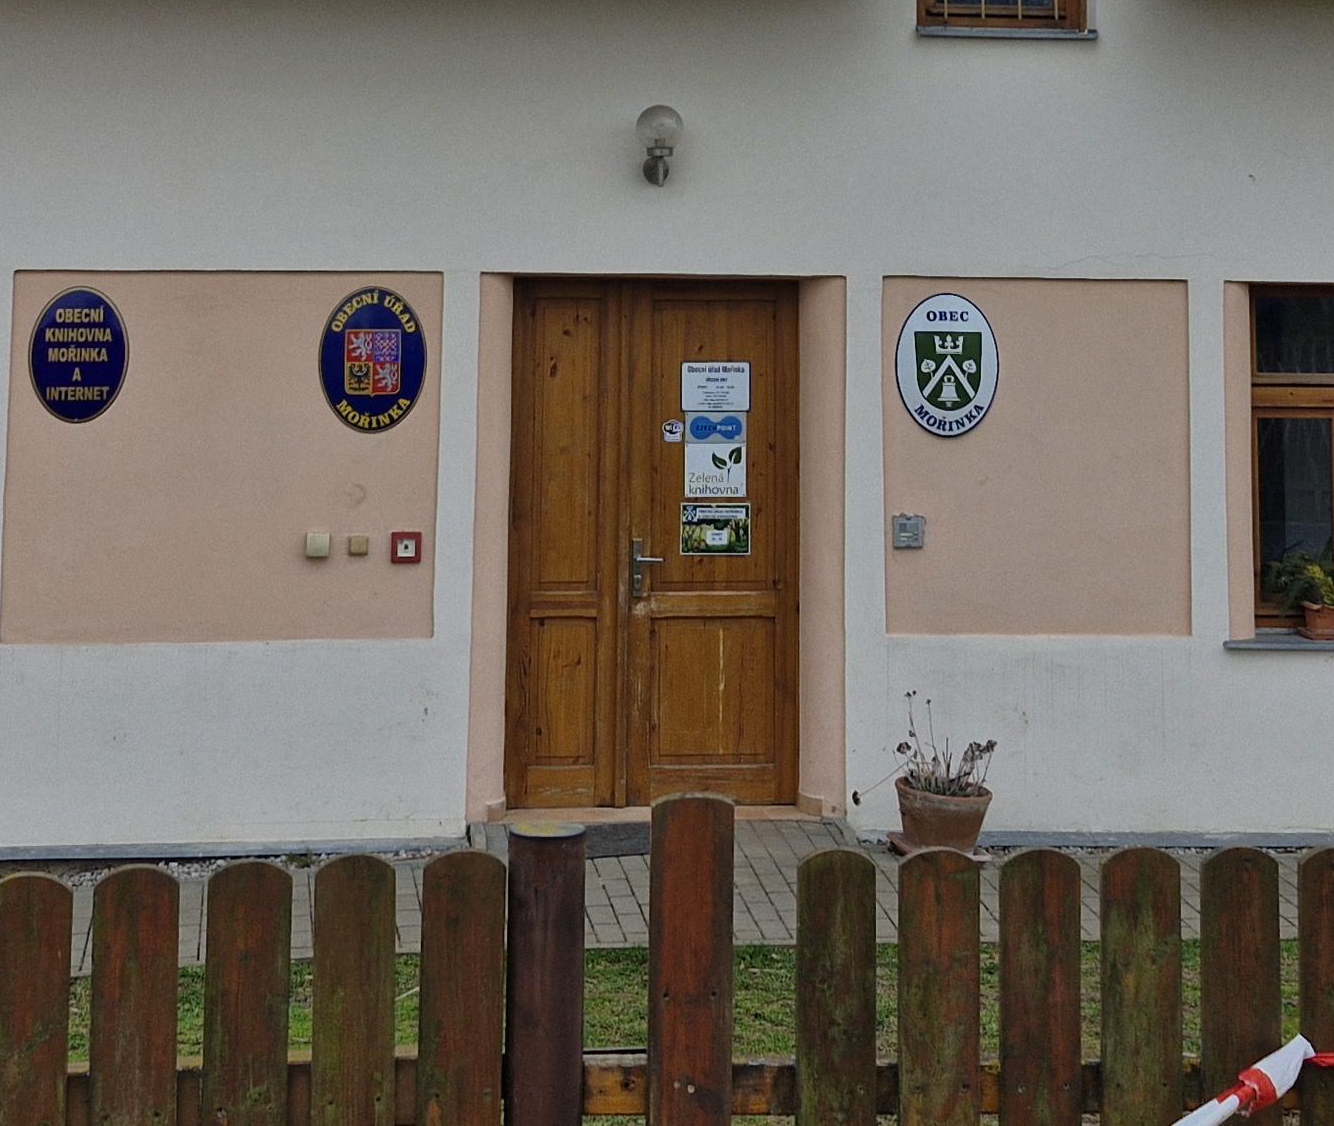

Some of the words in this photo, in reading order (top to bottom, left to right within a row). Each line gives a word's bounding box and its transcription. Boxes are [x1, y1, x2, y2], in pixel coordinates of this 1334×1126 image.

[55, 305, 104, 323] OBECNÍ
[331, 290, 380, 333] OBECNÍ
[383, 295, 417, 333] ÚŘAD
[926, 310, 969, 322] OBEC
[45, 327, 113, 343] KNIHOVNA
[48, 344, 109, 363] MOŘINKA
[71, 367, 82, 382] A
[46, 386, 110, 401] INTERNET
[335, 397, 411, 429] MOŘINKA
[914, 404, 984, 432] MOŘINKA
[689, 472, 724, 483] Zelená
[689, 484, 739, 495] knihovna
